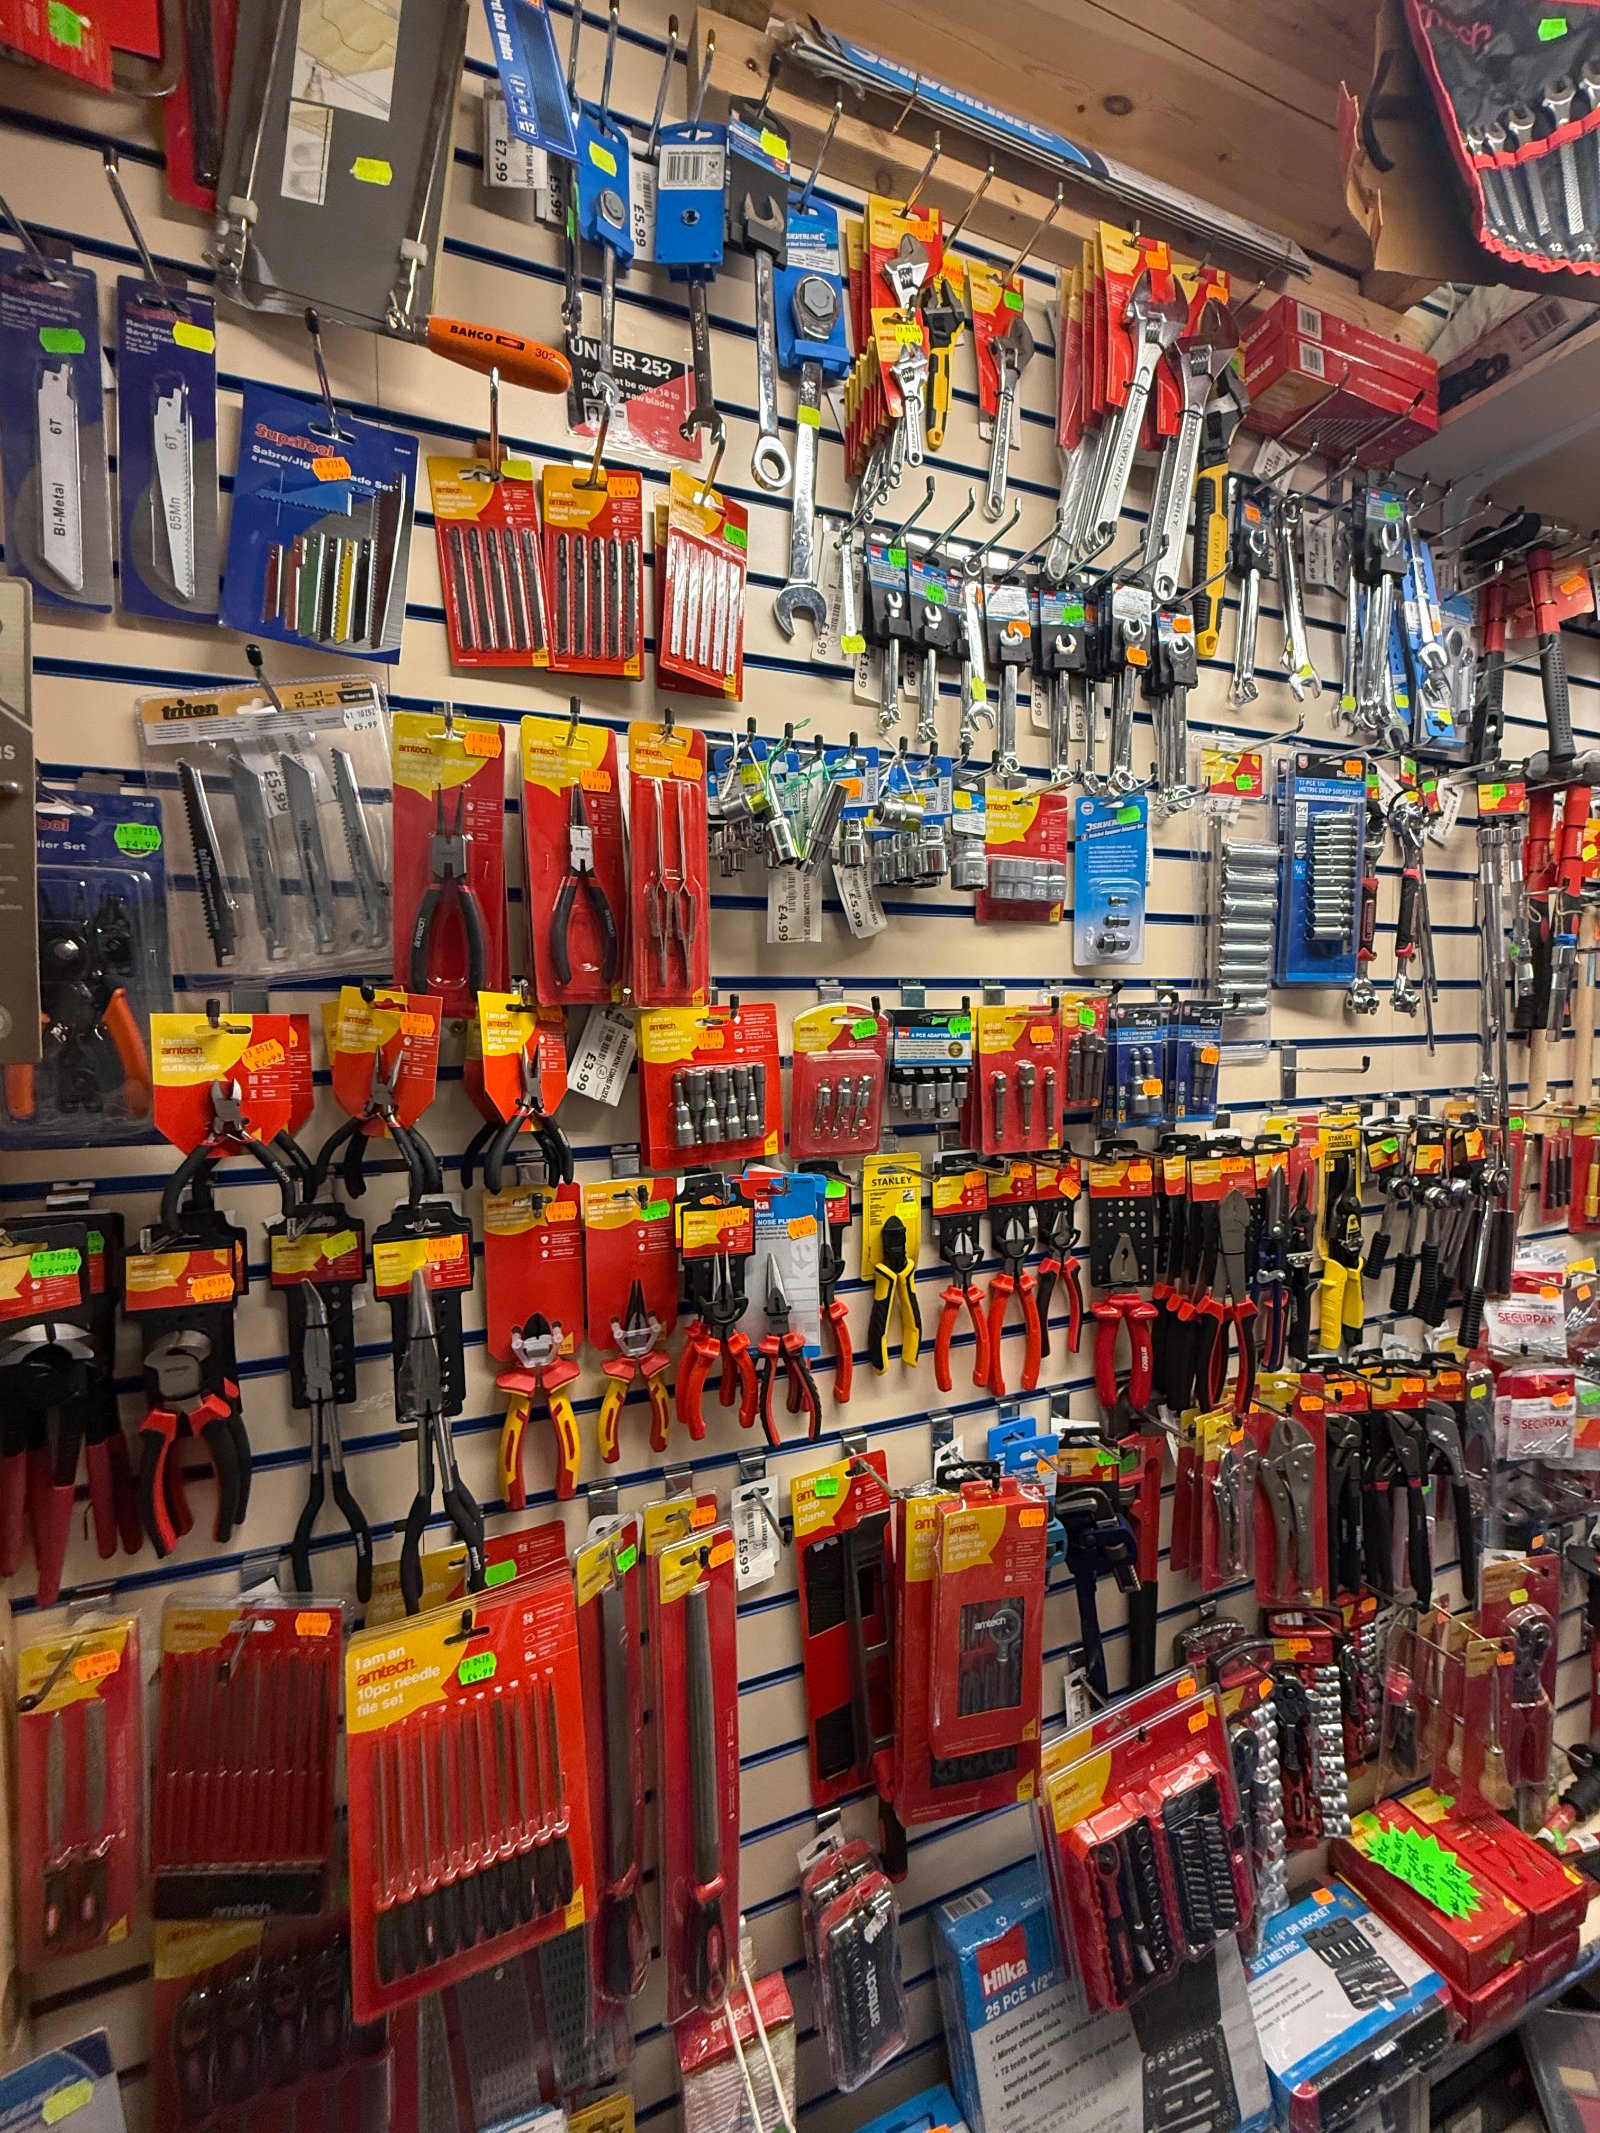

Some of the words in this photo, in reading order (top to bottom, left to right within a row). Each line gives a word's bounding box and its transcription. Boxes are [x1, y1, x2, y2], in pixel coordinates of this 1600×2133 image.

[497, 32, 514, 62] Blades
[870, 55, 1054, 143] SILVERLINE
[495, 139, 508, 182] £7.99
[550, 175, 562, 217] £5.99
[633, 205, 646, 247] £5.99
[450, 325, 493, 342] BAHCO
[570, 339, 636, 370] UNER
[641, 358, 673, 379] 25?
[625, 378, 636, 388] be
[638, 382, 657, 394] over
[659, 384, 670, 397] 18
[671, 389, 680, 400] to
[645, 394, 675, 411] blades
[50, 418, 62, 435] 6T
[255, 423, 335, 458] SupaTool
[165, 434, 177, 450] 6T
[252, 445, 313, 470] Sabre/Jig
[350, 475, 372, 487] ade
[375, 480, 394, 492] Set
[906, 652, 916, 687] £1.99
[161, 699, 219, 720] triton
[1034, 682, 1042, 716] £1.99
[353, 721, 378, 731] £5.99
[1075, 702, 1083, 737] £1.99
[398, 744, 433, 755] amtech.
[529, 746, 558, 757] amtech.
[635, 747, 663, 757] amtech.
[37, 840, 61, 850] lier
[63, 842, 86, 851] Set
[778, 904, 788, 942] £4.99
[848, 893, 863, 928] £5.99
[486, 1020, 514, 1028] amtech.
[649, 1023, 677, 1031] amtech.
[161, 1046, 204, 1055] amtech.
[255, 1042, 274, 1056] 0526
[577, 1052, 597, 1091] £3.99
[1327, 1134, 1353, 1142] STANLEY
[871, 1176, 912, 1187] STANLEY
[1498, 1312, 1556, 1325] SECURPAK
[798, 1500, 820, 1514] rasp
[799, 1509, 826, 1526] plane
[949, 1522, 981, 1535] amtech.
[738, 1538, 750, 1575] £5.99
[974, 1617, 1006, 1631] amtech
[355, 1657, 360, 1671] I
[361, 1652, 386, 1668] am
[386, 1646, 405, 1660] an
[356, 1656, 417, 1687] amtech.
[357, 1681, 392, 1702] 10pc
[393, 1665, 441, 1690] needle
[356, 1702, 379, 1718] file
[381, 1693, 404, 1708] set
[1286, 1923, 1302, 1936] DR
[1298, 1906, 1331, 1929] SOCKET
[1250, 1957, 1269, 1974] SET
[1266, 1940, 1300, 1964] METRIC
[982, 1957, 1028, 1997] Hilka
[866, 1960, 881, 2028] amtech.
[985, 2001, 1002, 2020] 25
[1003, 1989, 1029, 2013] PCE
[995, 2026, 1019, 2043] Carbon
[1019, 2013, 1036, 2029] steel
[998, 2042, 1018, 2059] Mirror
[1019, 2030, 1043, 2048] chrome
[1043, 2019, 1061, 2031] finish
[1028, 2045, 1046, 2060] quick
[1047, 2031, 1071, 2048] release
[1028, 2060, 1052, 2077] handle
[1020, 2085, 1038, 2100] drive
[1038, 2069, 1064, 2090] sockets
